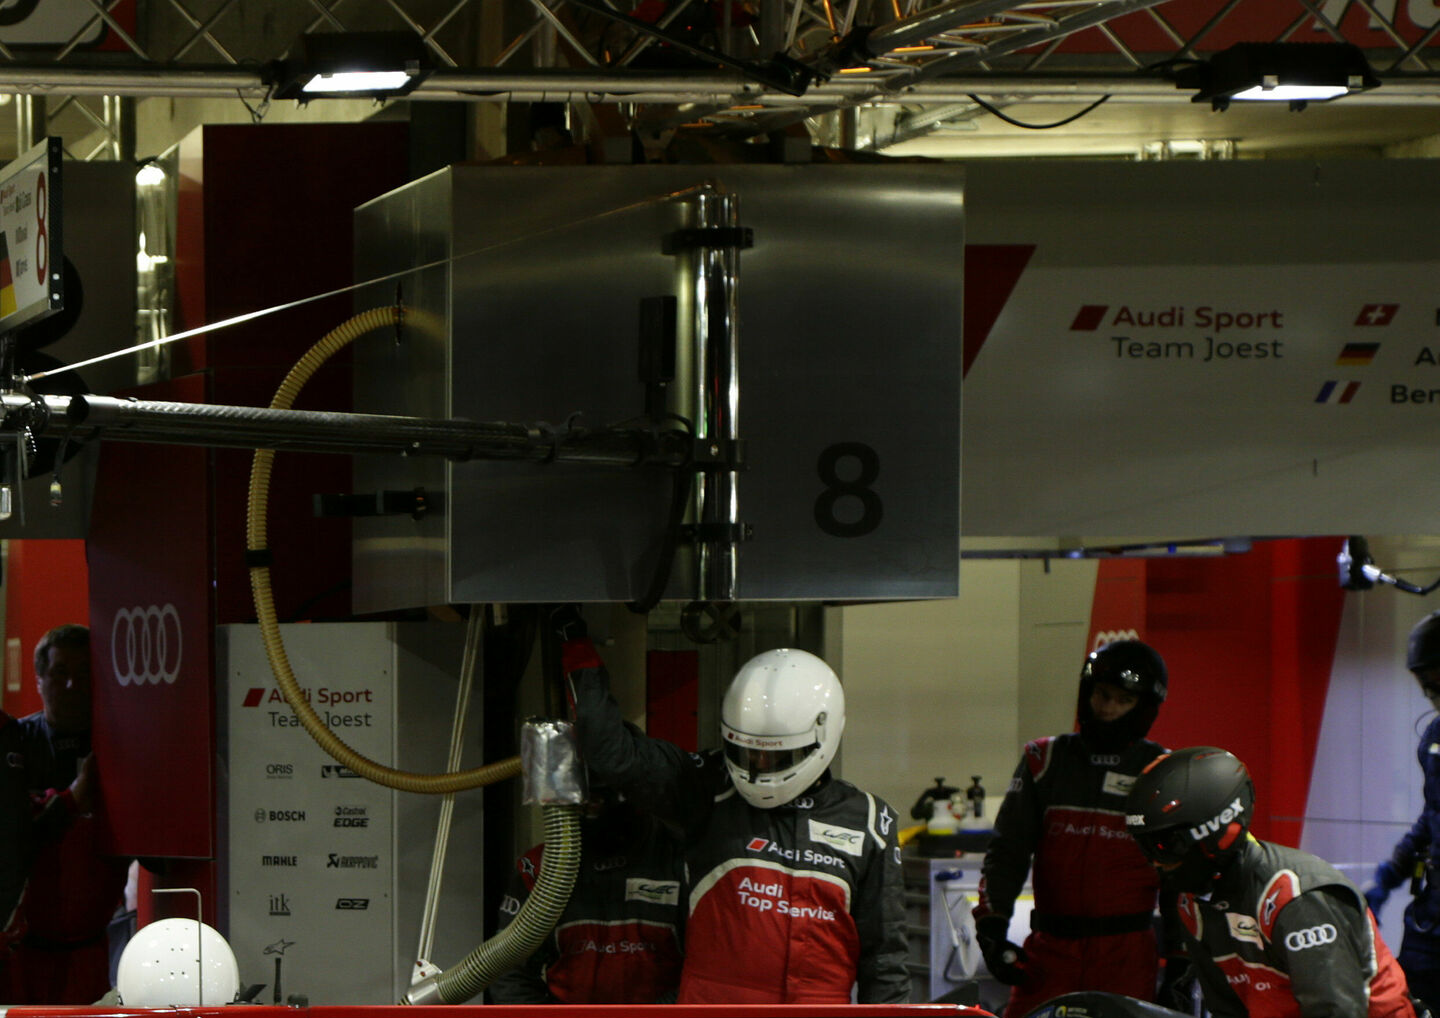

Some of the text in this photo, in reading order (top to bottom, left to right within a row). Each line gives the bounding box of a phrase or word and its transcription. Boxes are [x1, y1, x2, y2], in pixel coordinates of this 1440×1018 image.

[36, 171, 47, 286] 8
[1112, 306, 1283, 332] Audi Sport
[1112, 337, 1283, 361] Team Joest
[814, 442, 884, 538] 8
[318, 688, 373, 707] Sport
[268, 711, 372, 728] Tea Joest
[734, 735, 783, 747] Audi Sport
[266, 764, 294, 775] ORIS
[269, 811, 306, 821] BOSCH
[334, 818, 369, 828] EDGE
[1125, 814, 1146, 826] vex
[1189, 797, 1245, 841] uvex
[1065, 823, 1096, 835] Audi
[262, 855, 298, 867] MAHLE
[767, 842, 846, 869] Audi Sport
[737, 877, 784, 898] Audi
[269, 894, 290, 912] itk
[337, 899, 369, 910] OZ
[737, 891, 836, 921] Top Service
